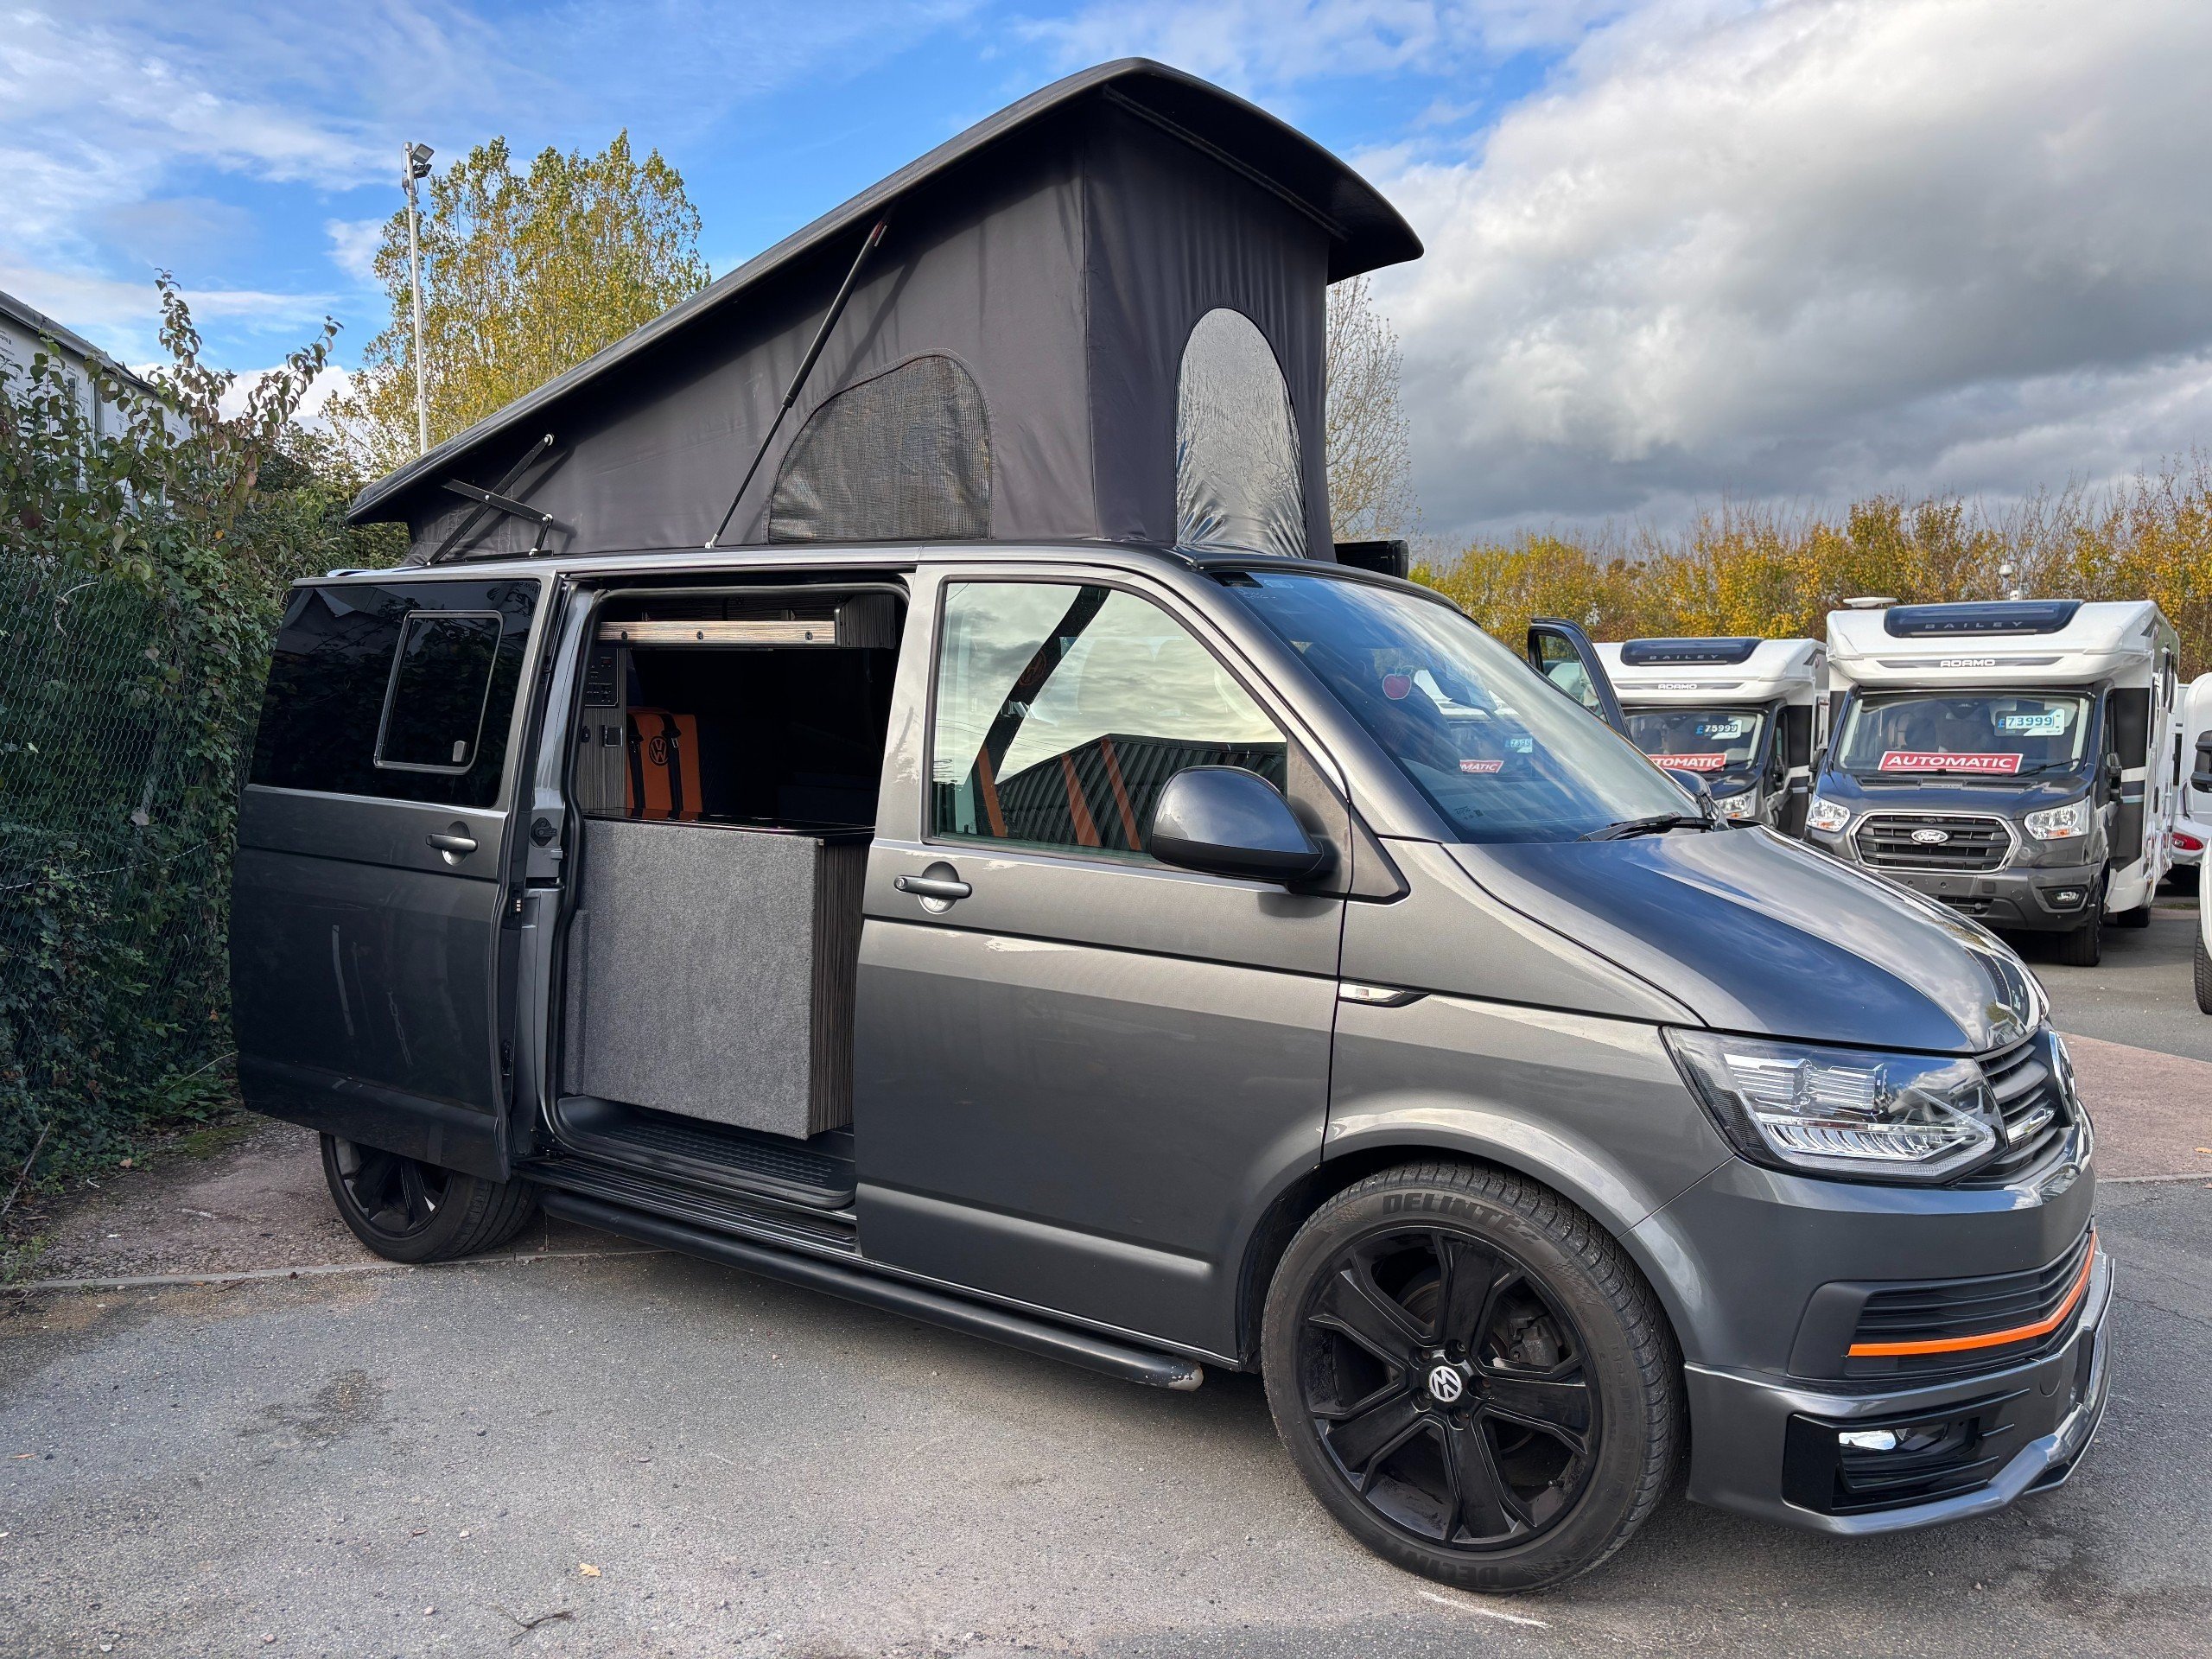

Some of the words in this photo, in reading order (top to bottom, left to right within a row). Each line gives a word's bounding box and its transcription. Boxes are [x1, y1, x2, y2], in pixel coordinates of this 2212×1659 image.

[1924, 621, 2023, 630] BAILEY
[1652, 757, 1722, 767] TOMATIC
[1886, 755, 2013, 768] AUTOMATIC
[1382, 1192, 1525, 1232] DELINTE
